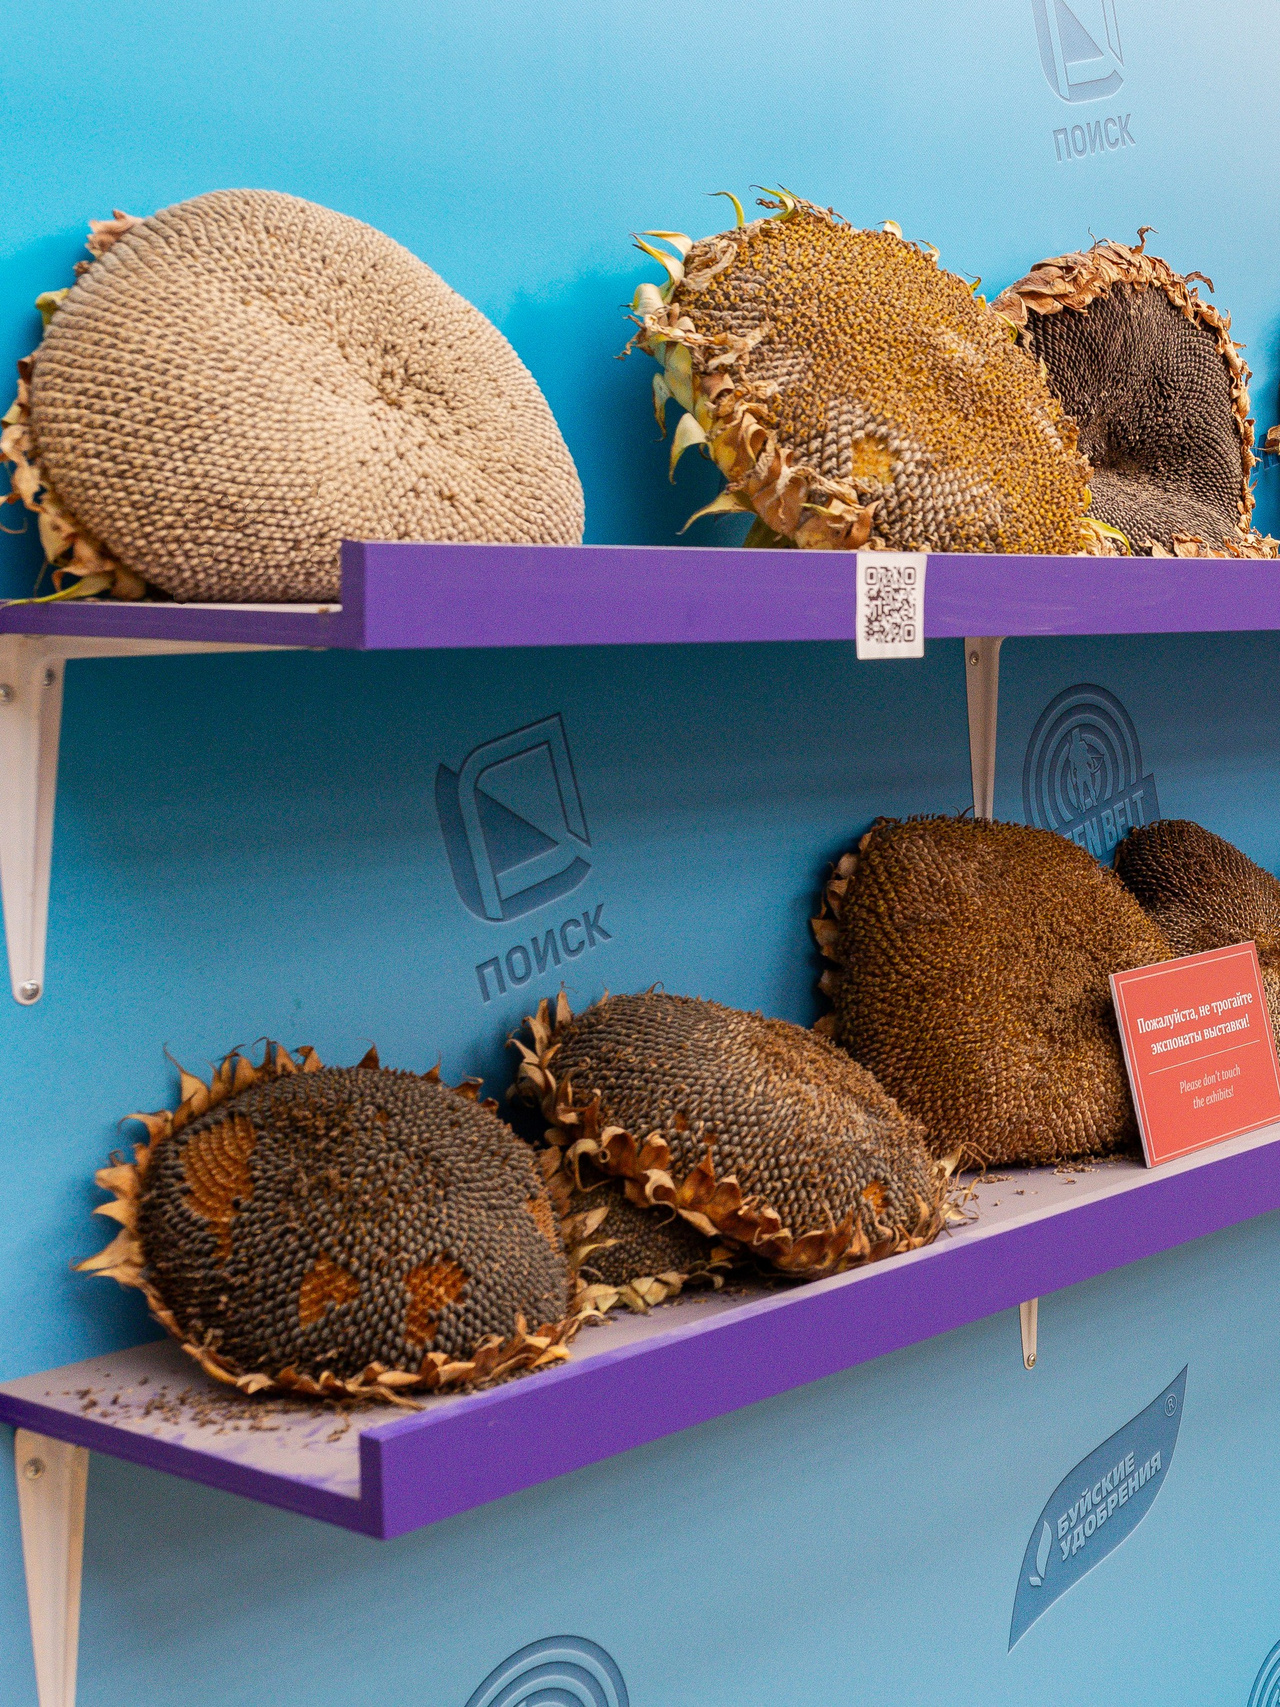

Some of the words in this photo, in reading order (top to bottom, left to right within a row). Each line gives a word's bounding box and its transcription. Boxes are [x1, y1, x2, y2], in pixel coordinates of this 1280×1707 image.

[1053, 113, 1136, 162] ПОИСК
[475, 902, 613, 1004] ПОИСК
[1136, 1008, 1199, 1034] Пожалуйста,
[1198, 1003, 1212, 1017] не
[1211, 991, 1253, 1016] трогайте
[1150, 1030, 1203, 1056] экспонаты
[1202, 1013, 1251, 1040] выставки!
[1179, 1078, 1203, 1095] Please
[1221, 1063, 1241, 1080] touch
[1193, 1095, 1205, 1109] the
[1205, 1084, 1235, 1105] exhibits!
[1057, 1451, 1136, 1540] БУЙСКИЕ
[1060, 1450, 1163, 1562] УДОБРЕНИЯ
